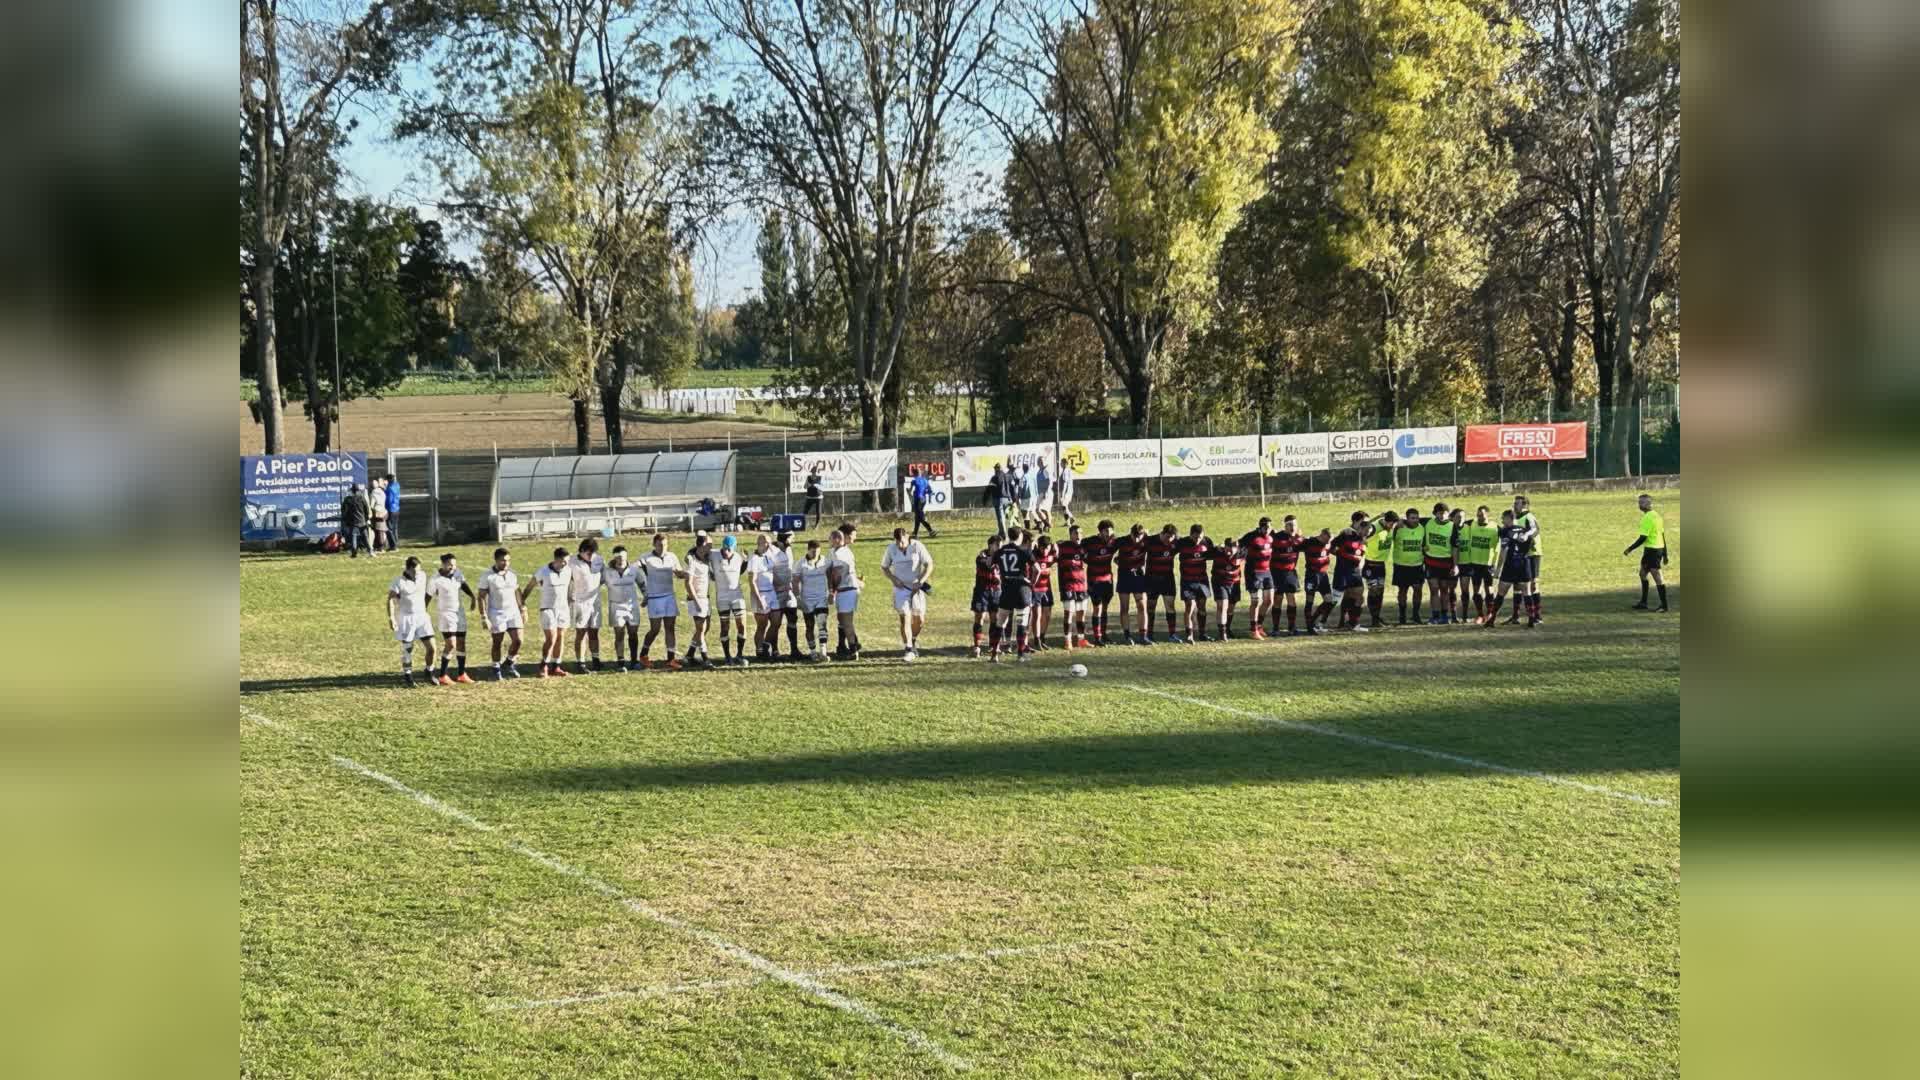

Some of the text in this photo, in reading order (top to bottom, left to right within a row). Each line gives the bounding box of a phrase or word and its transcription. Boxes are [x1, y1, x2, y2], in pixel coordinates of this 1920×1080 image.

[255, 457, 353, 475] A Pier Paolo
[255, 476, 303, 487] Presidente
[304, 476, 320, 486] per
[1000, 554, 1020, 572] 12
